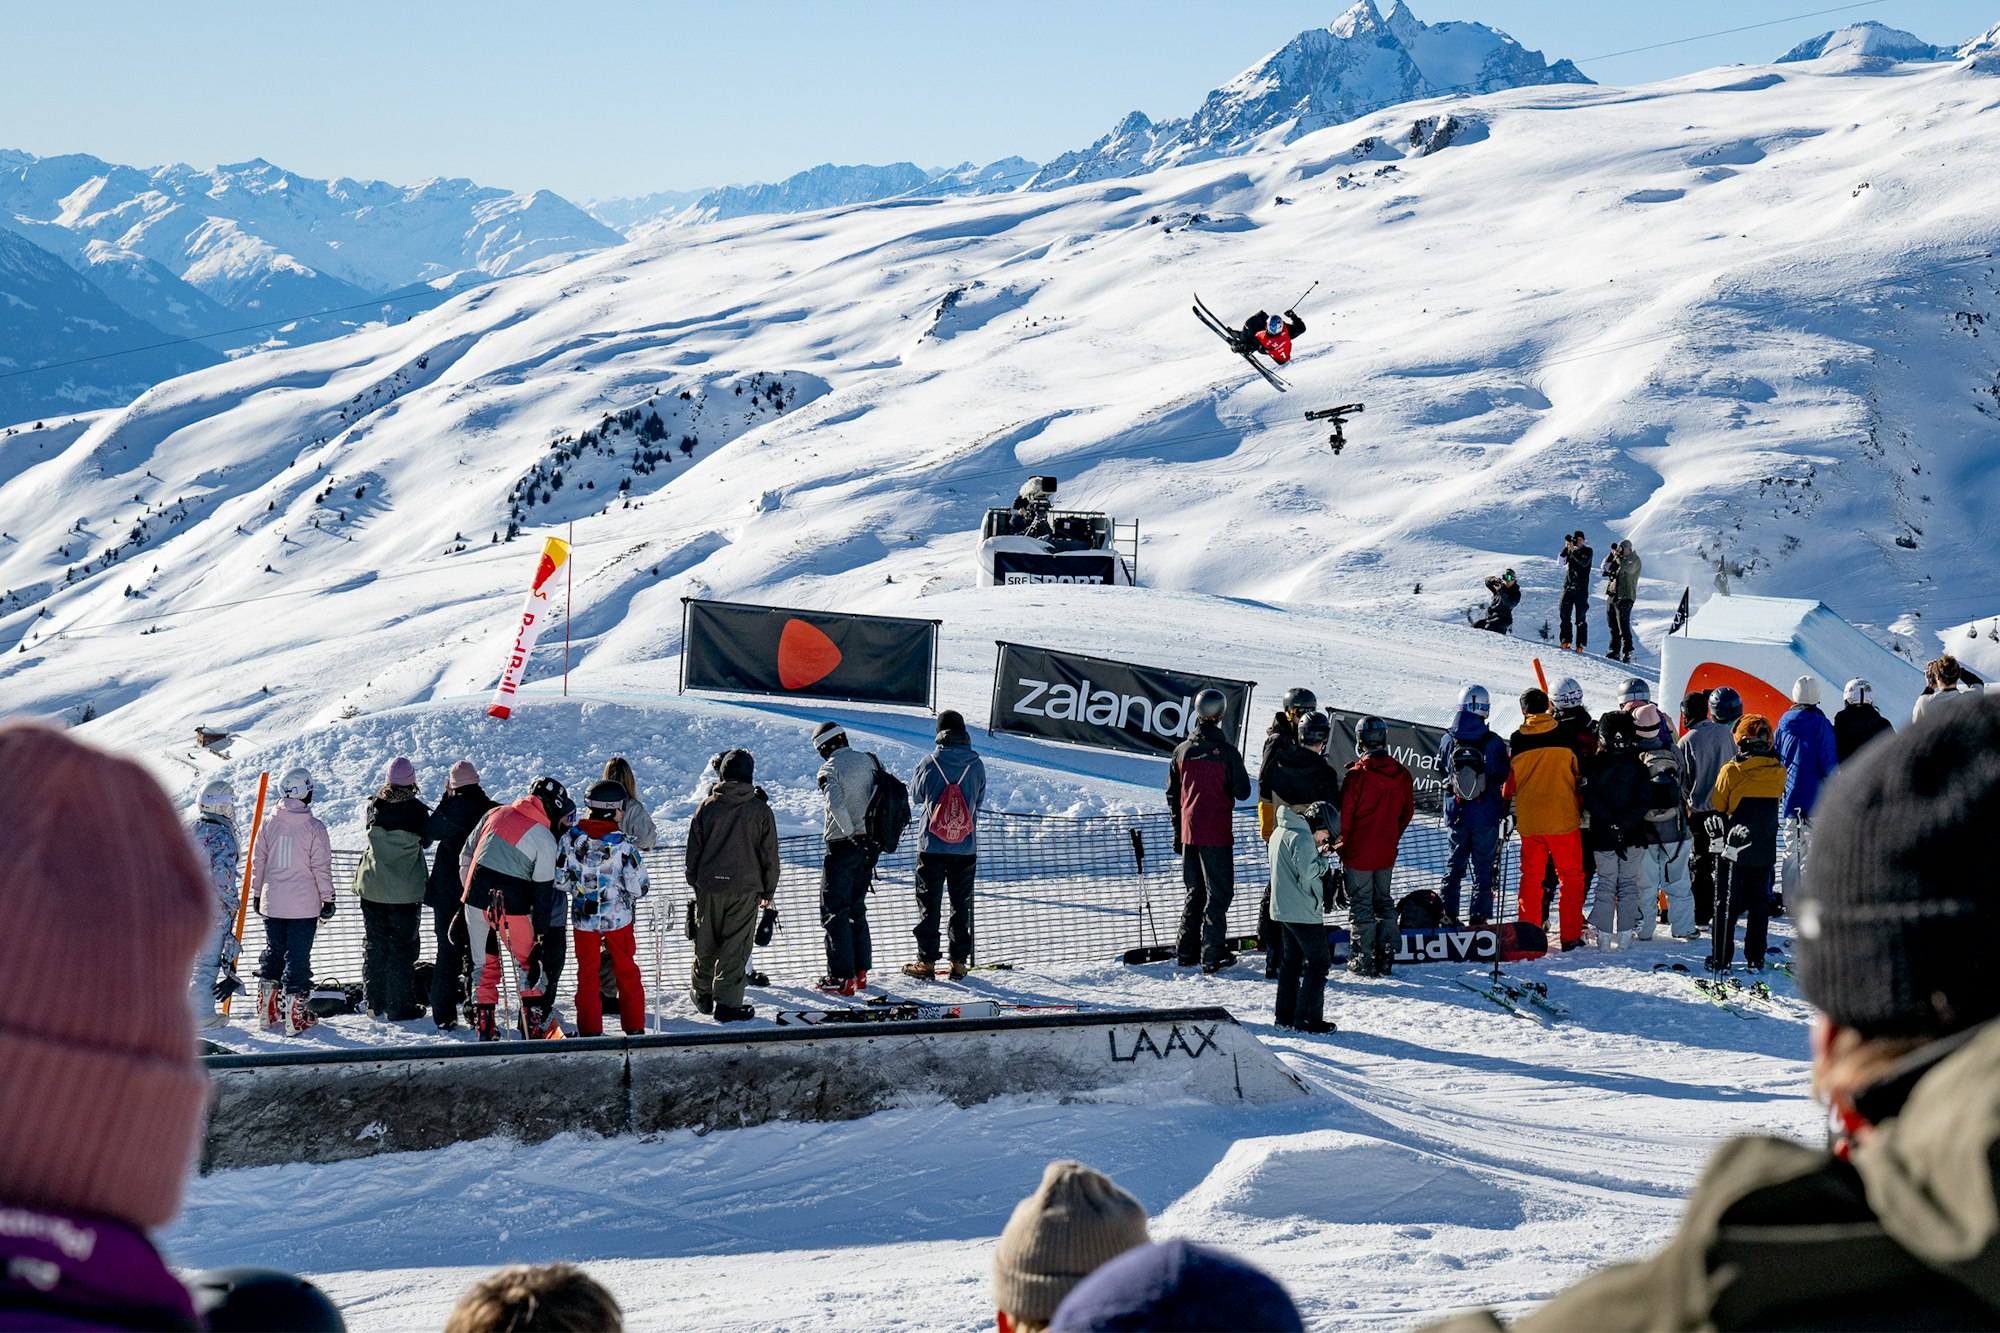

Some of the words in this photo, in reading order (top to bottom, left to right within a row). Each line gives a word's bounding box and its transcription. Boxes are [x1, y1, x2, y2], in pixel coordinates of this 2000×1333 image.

[1007, 576, 1028, 585] SRF
[1387, 744, 1442, 771] What
[1108, 1024, 1223, 1062] LAAX
